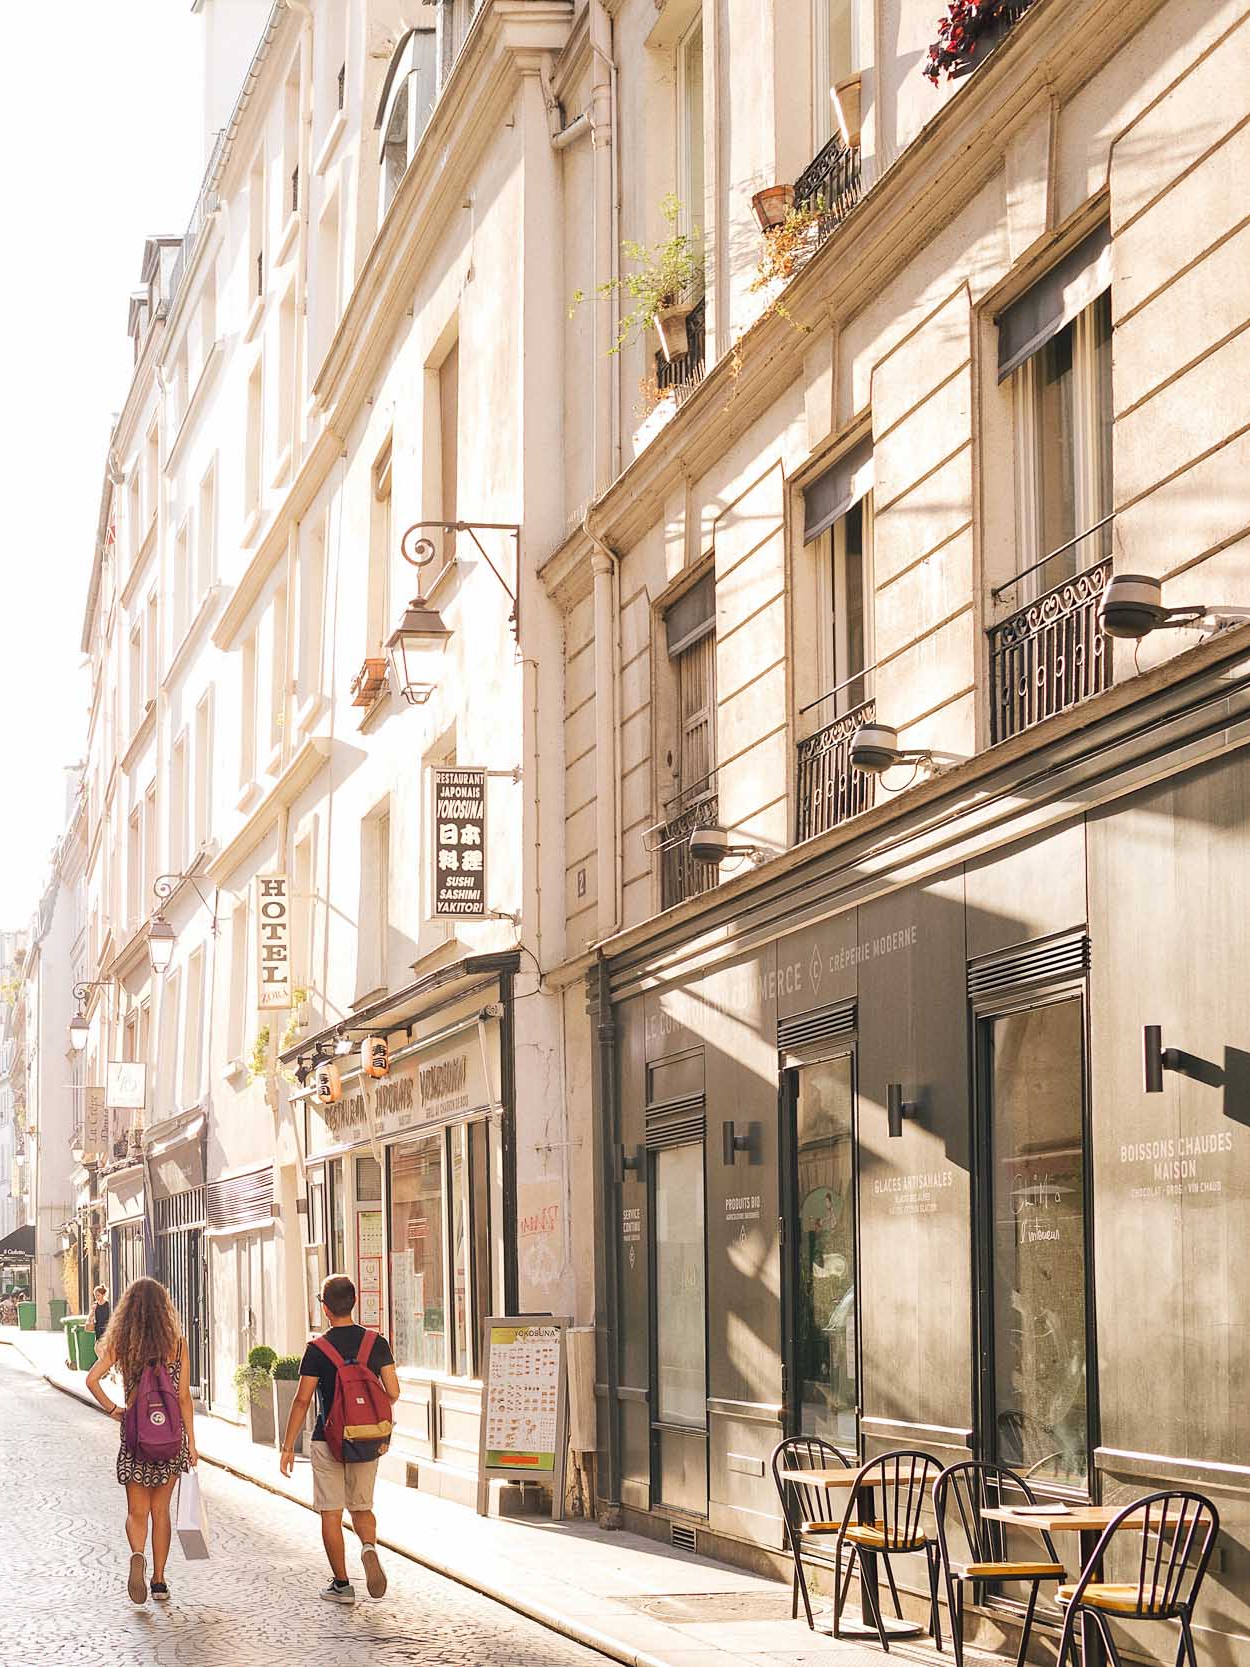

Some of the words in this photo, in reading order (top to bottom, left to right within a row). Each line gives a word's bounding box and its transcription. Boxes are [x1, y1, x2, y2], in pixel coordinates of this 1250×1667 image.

[436, 773, 484, 785] RESTAURANT
[440, 787, 480, 798] JAPONAIS
[437, 800, 484, 819] YOKOSUNA
[439, 823, 481, 845] 日本
[438, 849, 483, 871] 料理
[446, 876, 474, 887] SUSHI
[439, 889, 480, 900] SASHIMI
[437, 902, 484, 912] YAKITORI
[261, 880, 288, 983] HOTEL
[829, 943, 870, 972] CRÊPERIE
[873, 926, 917, 957] MODERNE
[1120, 1139, 1174, 1162] BOISSONS
[1178, 1132, 1232, 1156] CHAUDES
[1154, 1160, 1196, 1180] MAISON
[874, 1177, 901, 1194] GLACES
[903, 1171, 953, 1191] ARTISANALES
[725, 1197, 750, 1211] PRODUITS
[623, 1208, 640, 1220] SERVICE
[514, 1328, 556, 1337] YOKOSUNA
